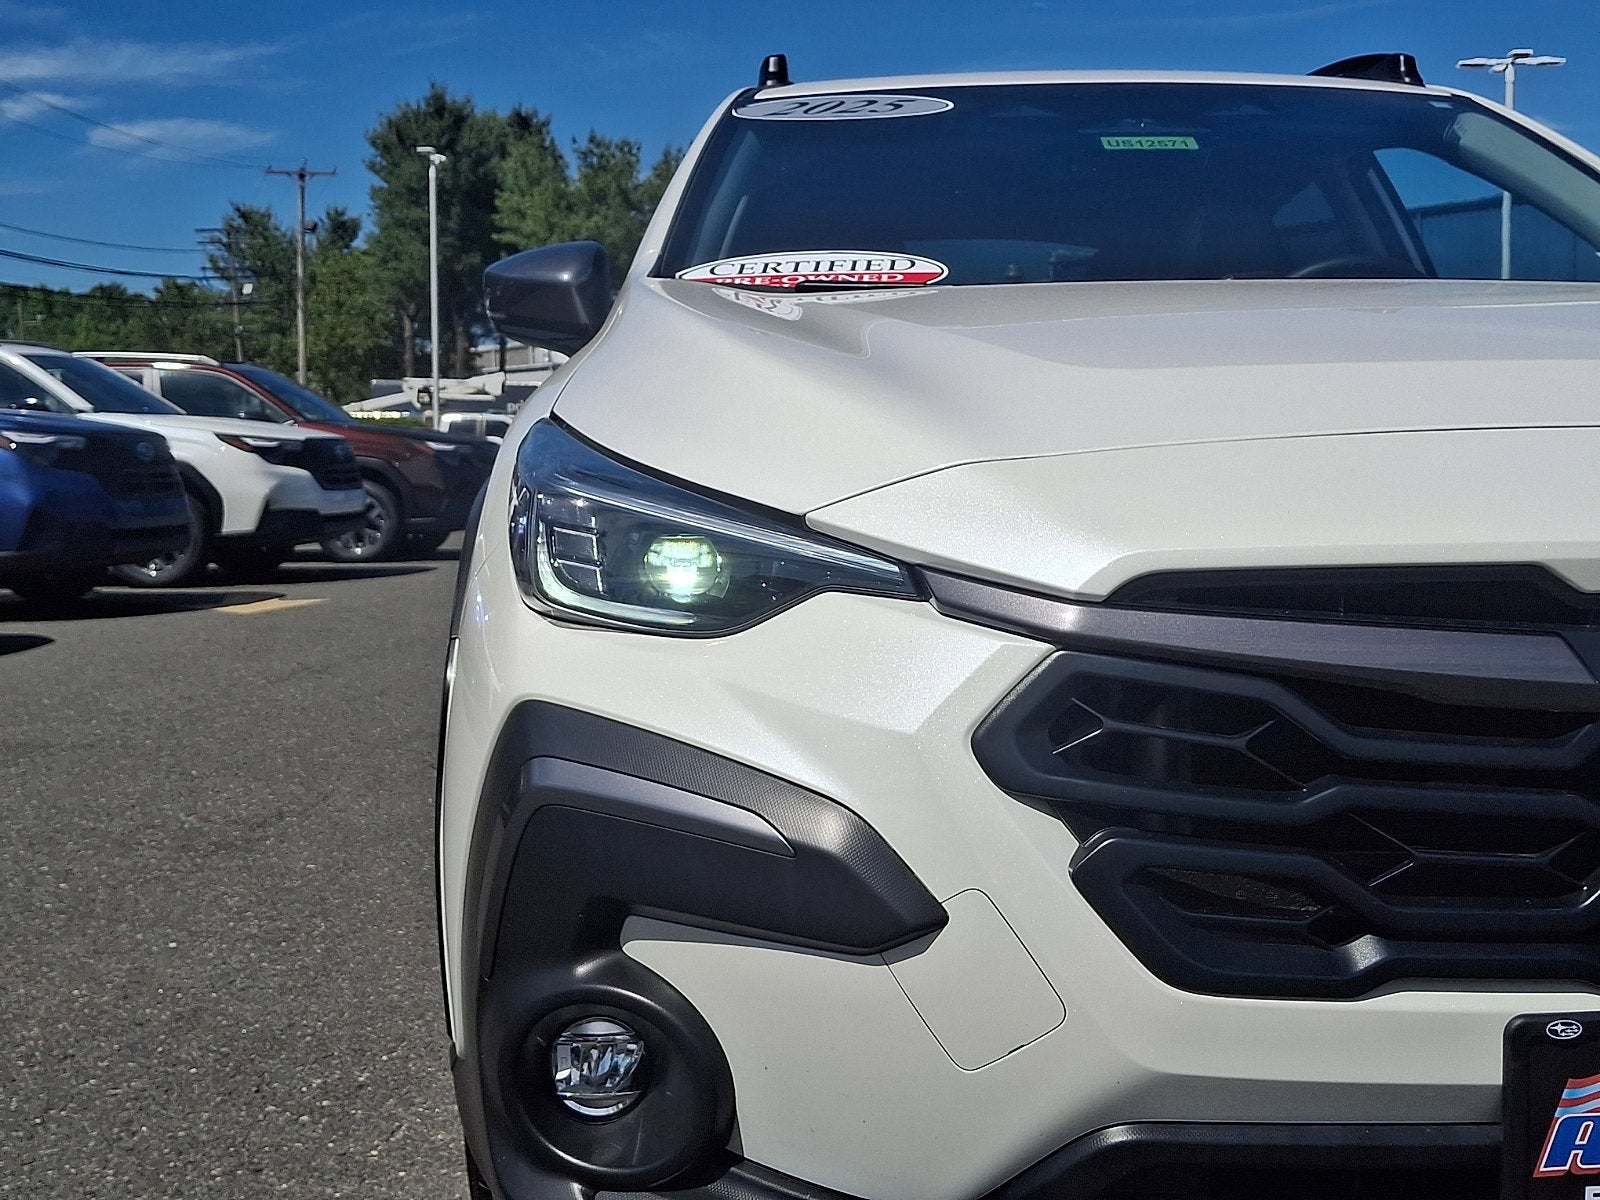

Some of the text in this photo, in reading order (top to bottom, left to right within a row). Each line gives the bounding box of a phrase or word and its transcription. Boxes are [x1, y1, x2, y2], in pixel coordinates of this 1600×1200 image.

[763, 100, 917, 116] 2025
[709, 258, 916, 275] CERTIFIED
[715, 273, 905, 285] PRE-OWNED
